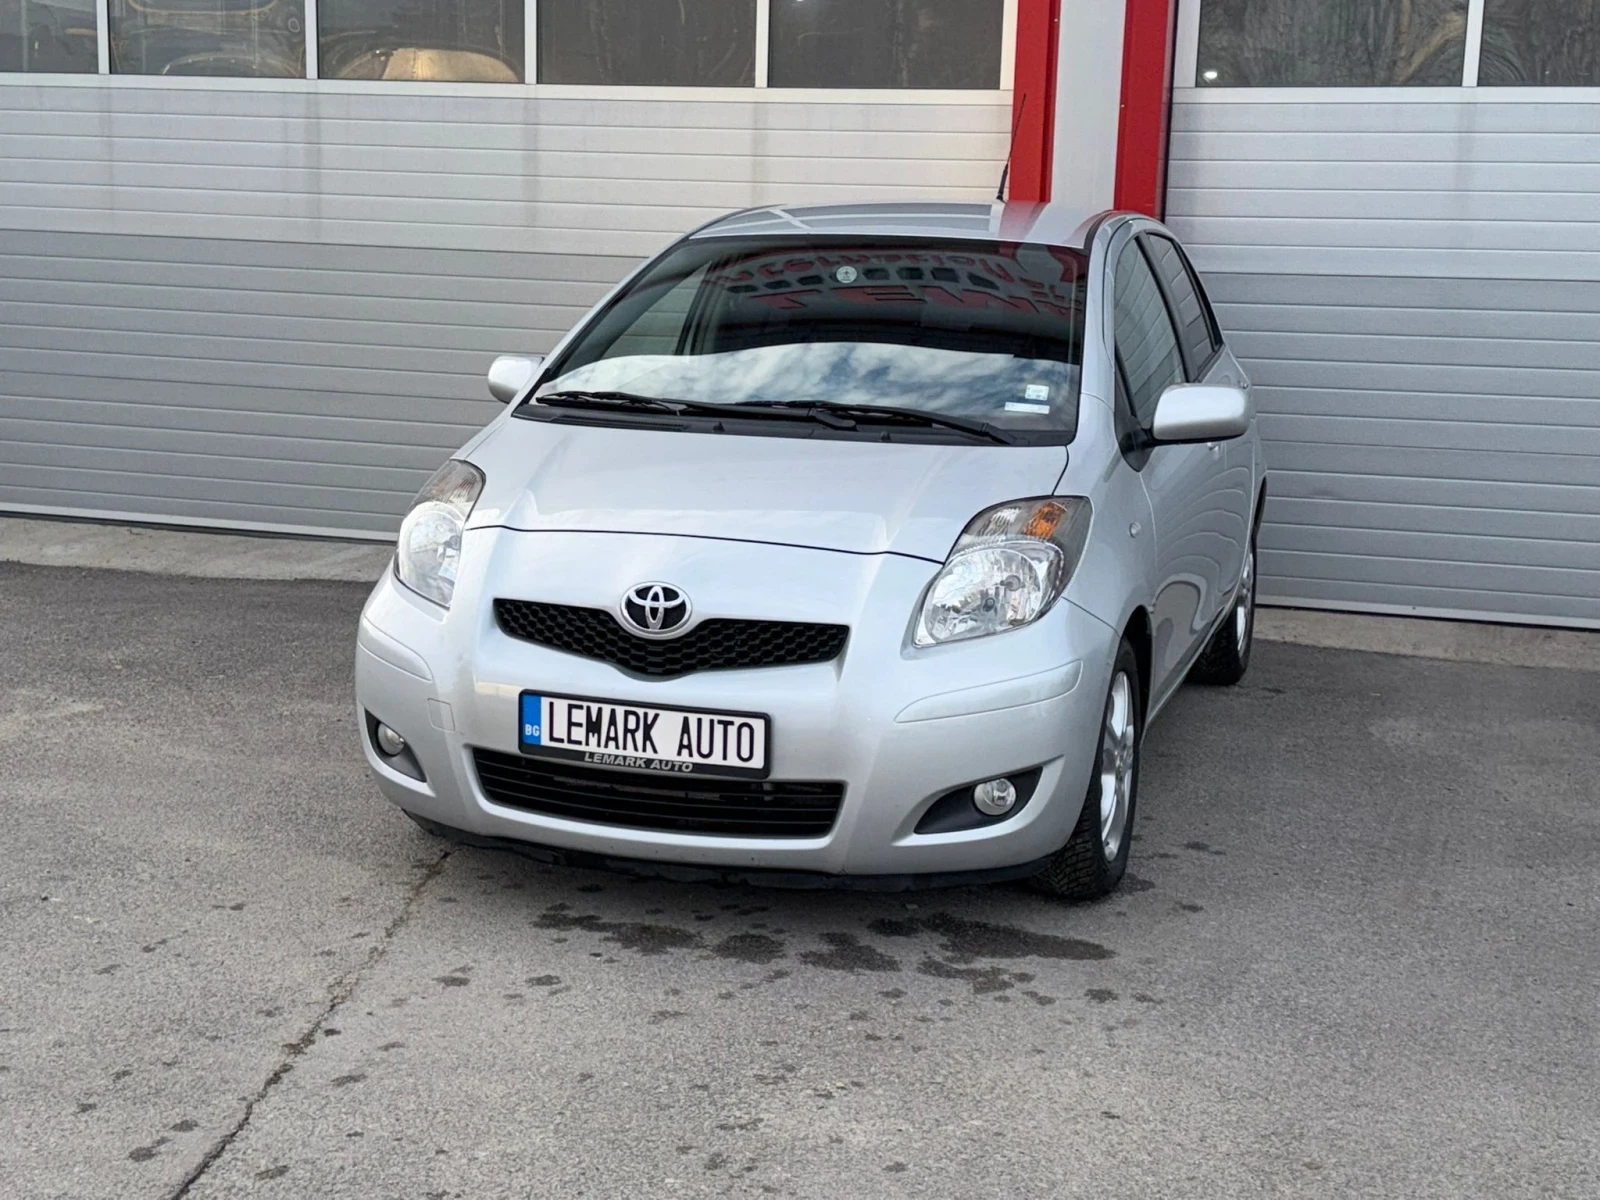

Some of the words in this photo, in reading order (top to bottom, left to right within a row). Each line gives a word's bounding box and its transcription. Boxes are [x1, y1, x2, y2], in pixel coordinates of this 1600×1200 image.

[525, 724, 540, 737] BG
[549, 701, 660, 754] LEMARK
[676, 716, 755, 762] AUTO
[584, 752, 647, 768] LEMARK
[649, 759, 694, 772] AUTO
